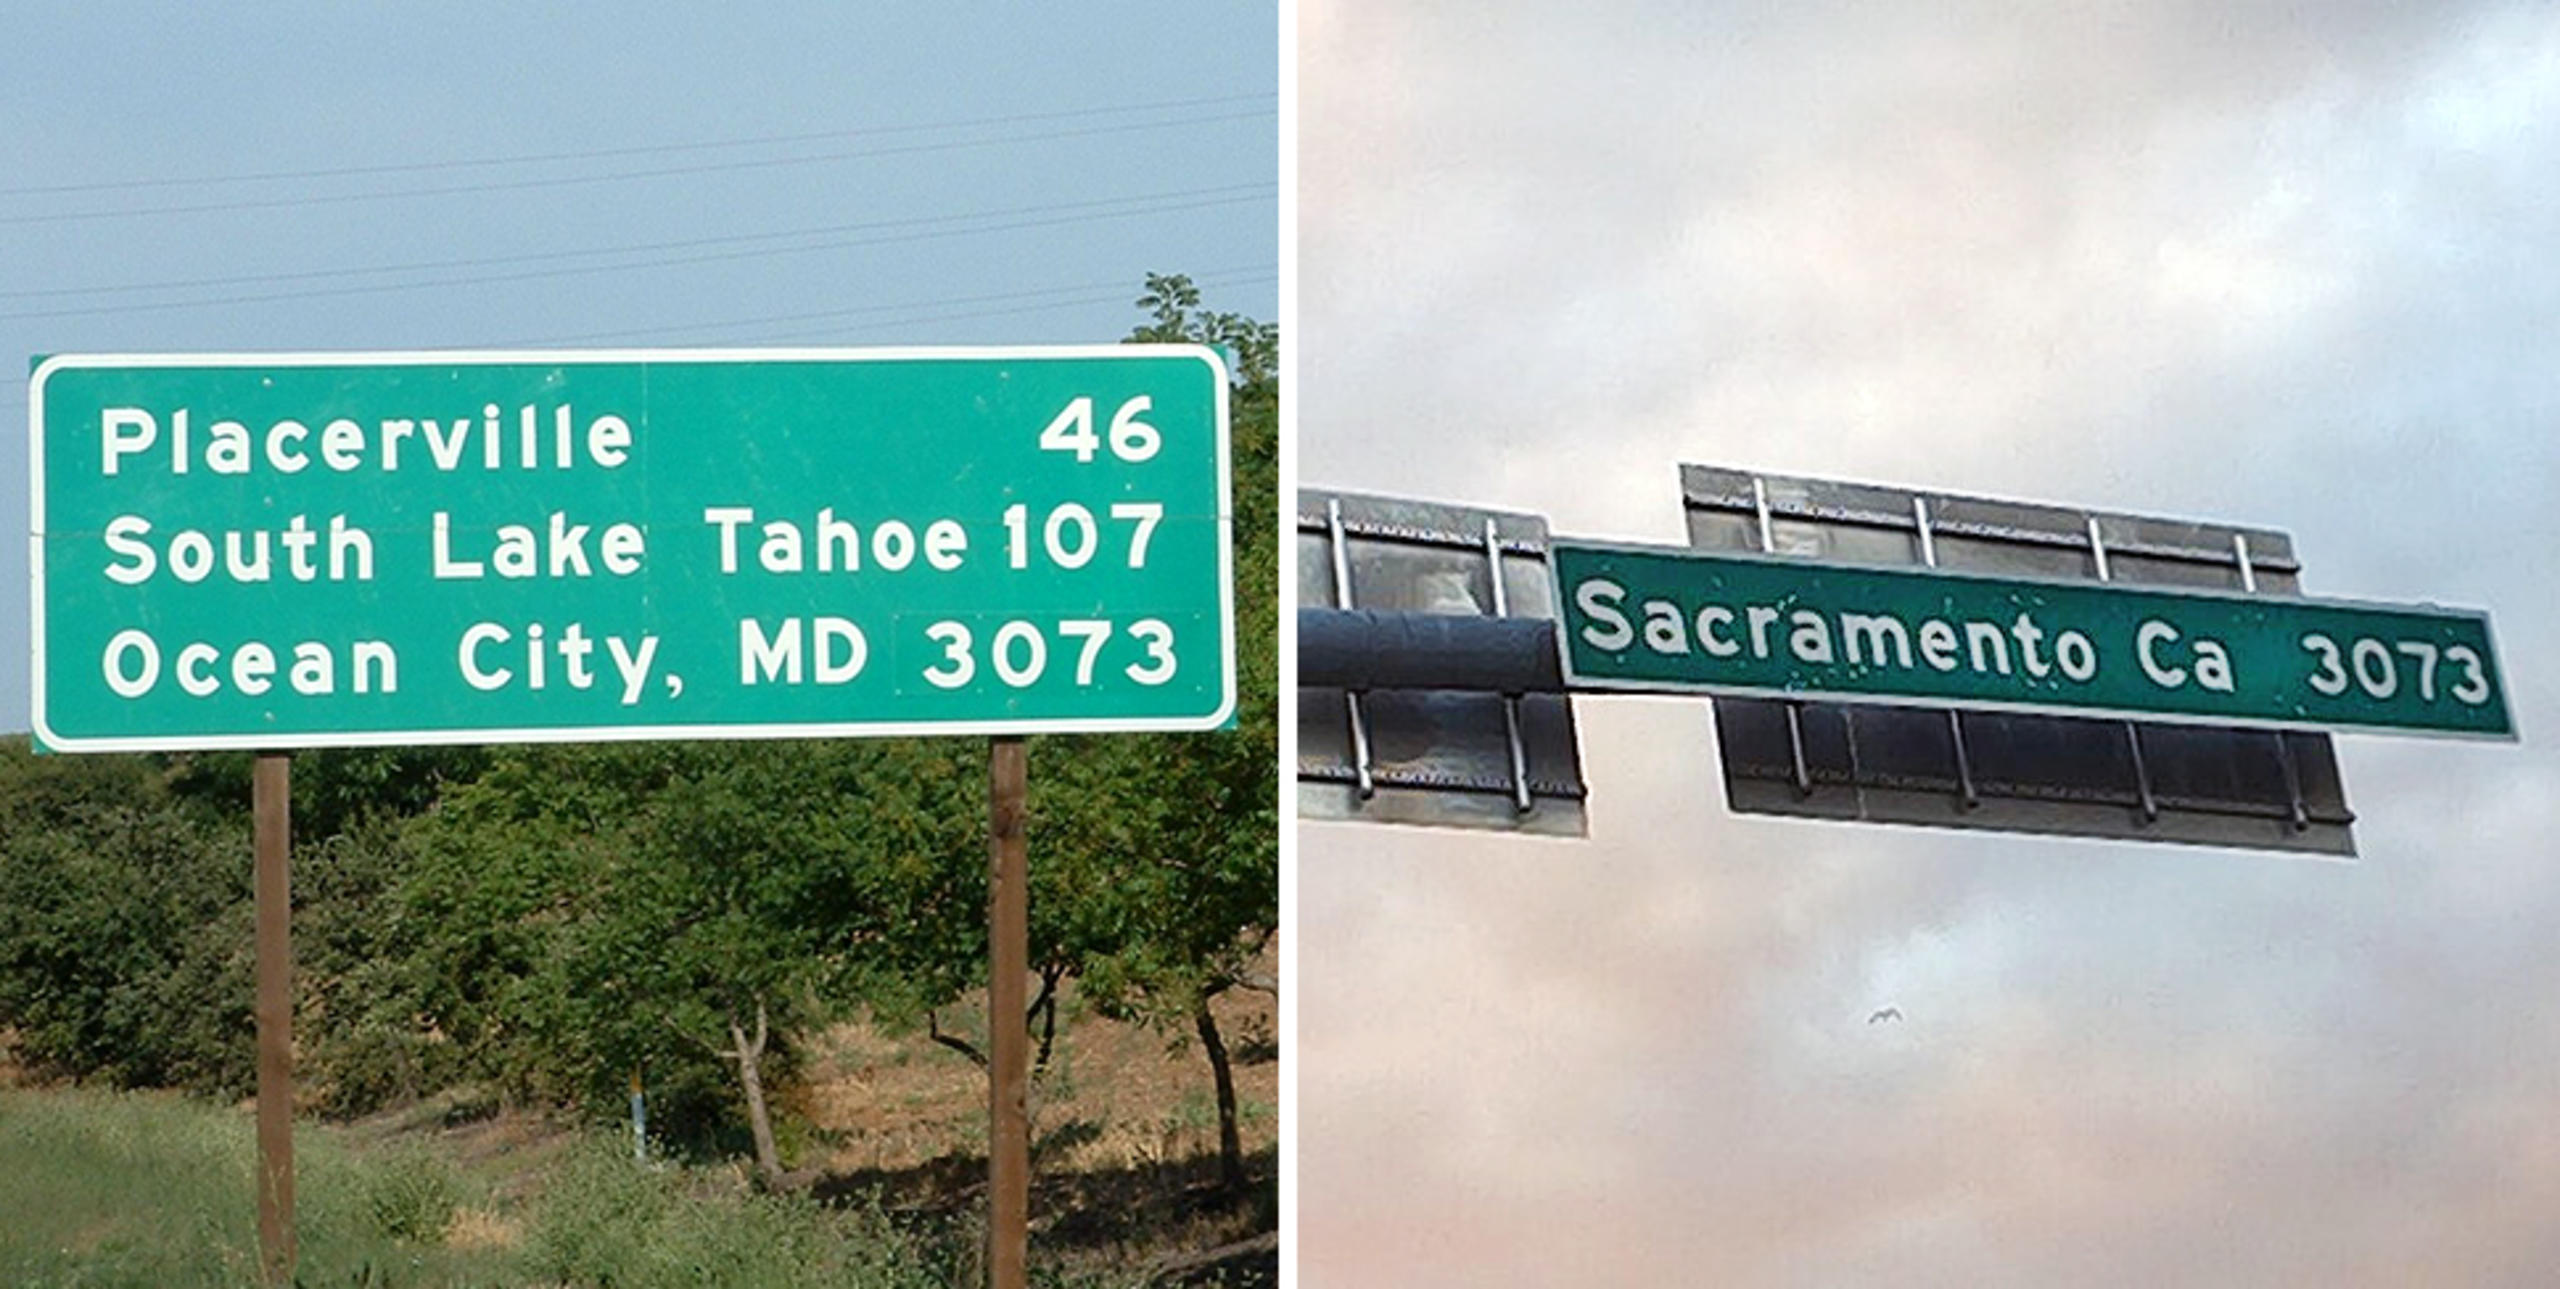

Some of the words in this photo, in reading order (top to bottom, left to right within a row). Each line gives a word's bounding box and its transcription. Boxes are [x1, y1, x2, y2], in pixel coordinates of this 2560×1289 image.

[101, 403, 633, 475] Placerville
[1039, 395, 1162, 463] 46
[103, 514, 374, 584] South
[432, 511, 646, 578] Lake
[704, 508, 968, 573] Tahoe
[1003, 503, 1164, 569] 107
[102, 629, 398, 698] Ocean
[458, 622, 684, 705] City,
[740, 617, 868, 686] MD
[922, 619, 1178, 688] 3073
[1575, 578, 2097, 682] Sacramento
[2136, 620, 2235, 693] Ca
[2302, 634, 2490, 705] 3073
